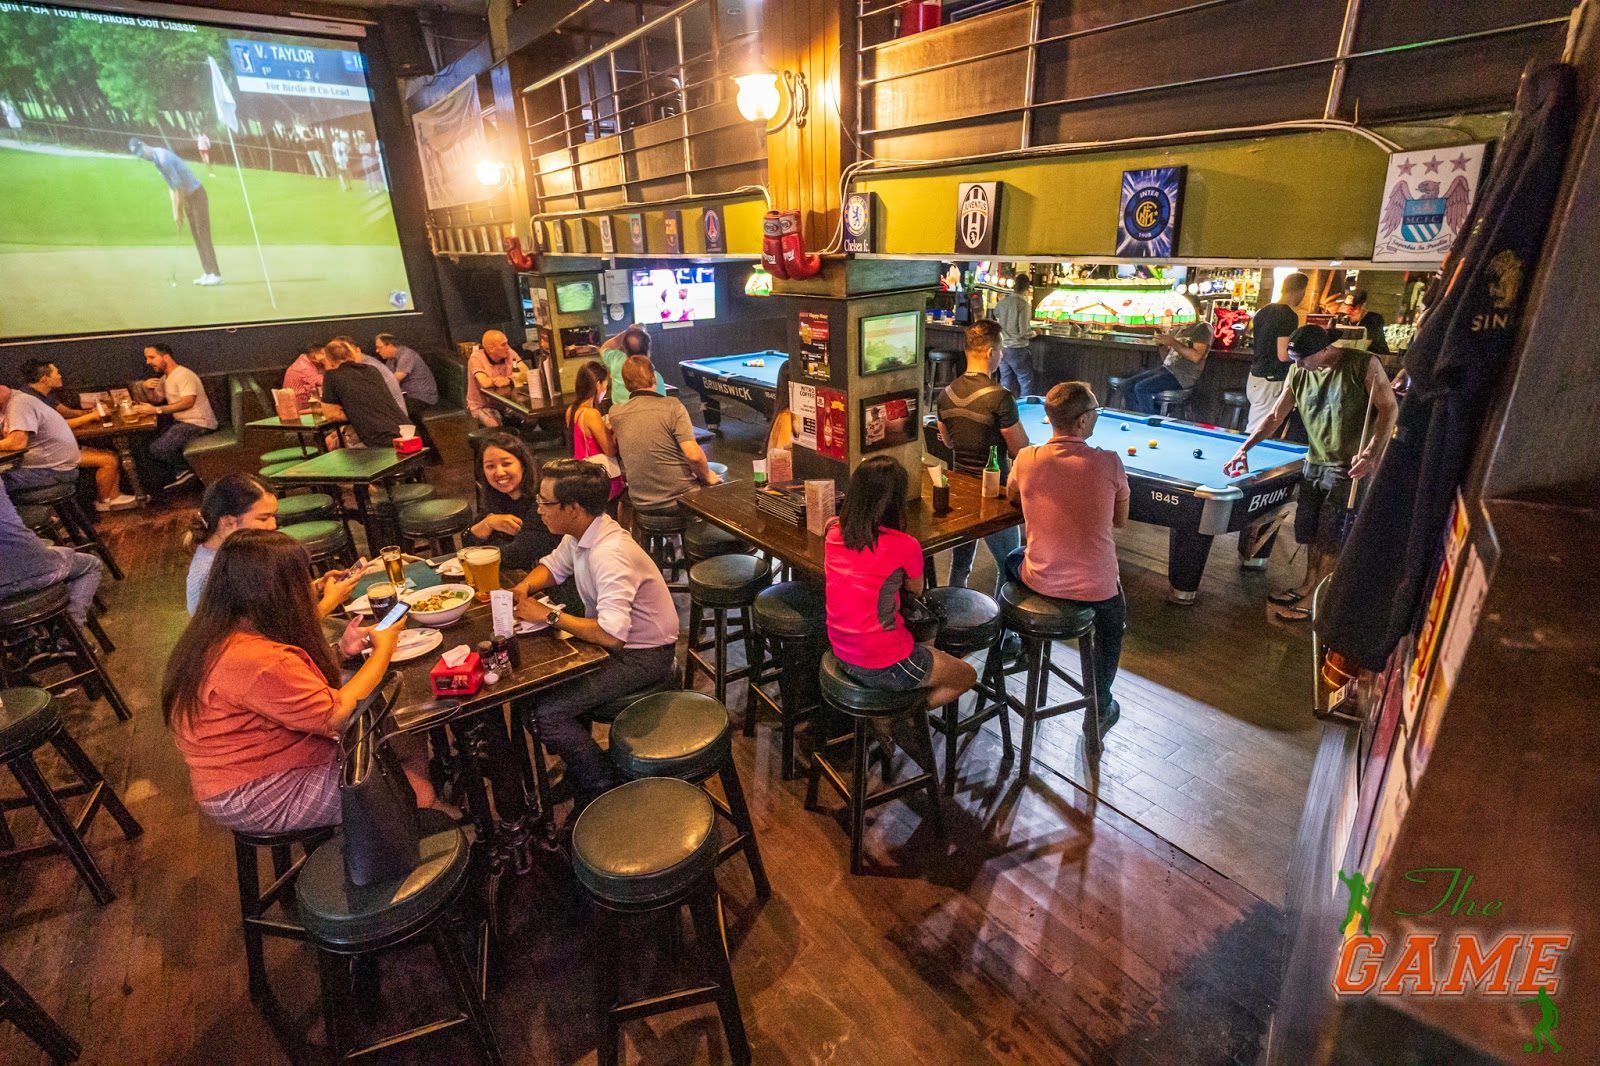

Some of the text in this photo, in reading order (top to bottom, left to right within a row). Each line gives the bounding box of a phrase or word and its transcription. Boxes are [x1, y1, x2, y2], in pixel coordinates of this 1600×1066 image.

[160, 20, 198, 33] Classic
[254, 44, 268, 59] V.
[270, 46, 315, 63] TAYLOR
[1140, 190, 1159, 198] INTER
[844, 239, 863, 252] Chelsea
[702, 376, 752, 400] BRUNSWICK
[1151, 490, 1179, 505] 1845
[1248, 487, 1287, 512] BRUN
